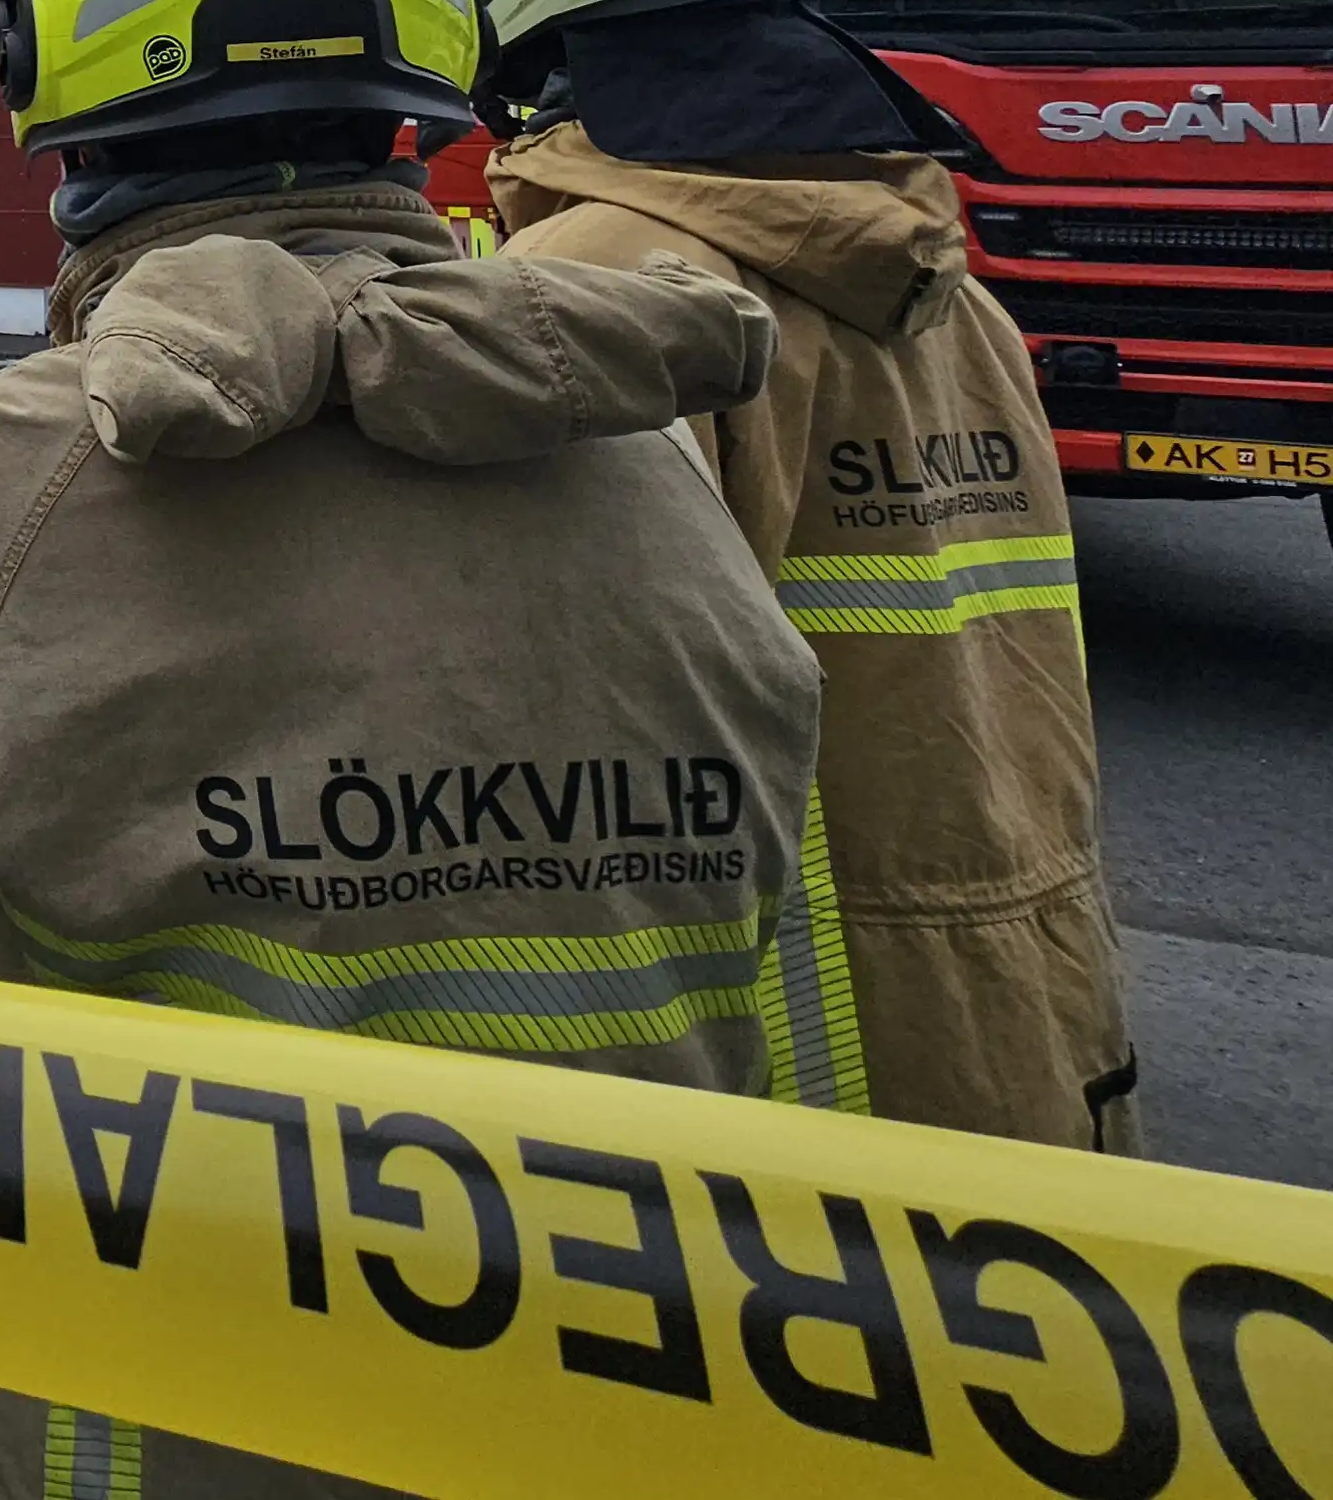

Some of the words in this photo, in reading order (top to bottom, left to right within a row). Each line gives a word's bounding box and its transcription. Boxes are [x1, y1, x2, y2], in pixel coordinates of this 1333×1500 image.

[259, 45, 317, 60] Stefán
[1037, 100, 1333, 144] SCANI
[1164, 442, 1227, 472] AK
[195, 756, 742, 861] SLÖKKVILIÐ
[203, 848, 747, 912] HÖFUÐBORGARSVÆÐISINS
